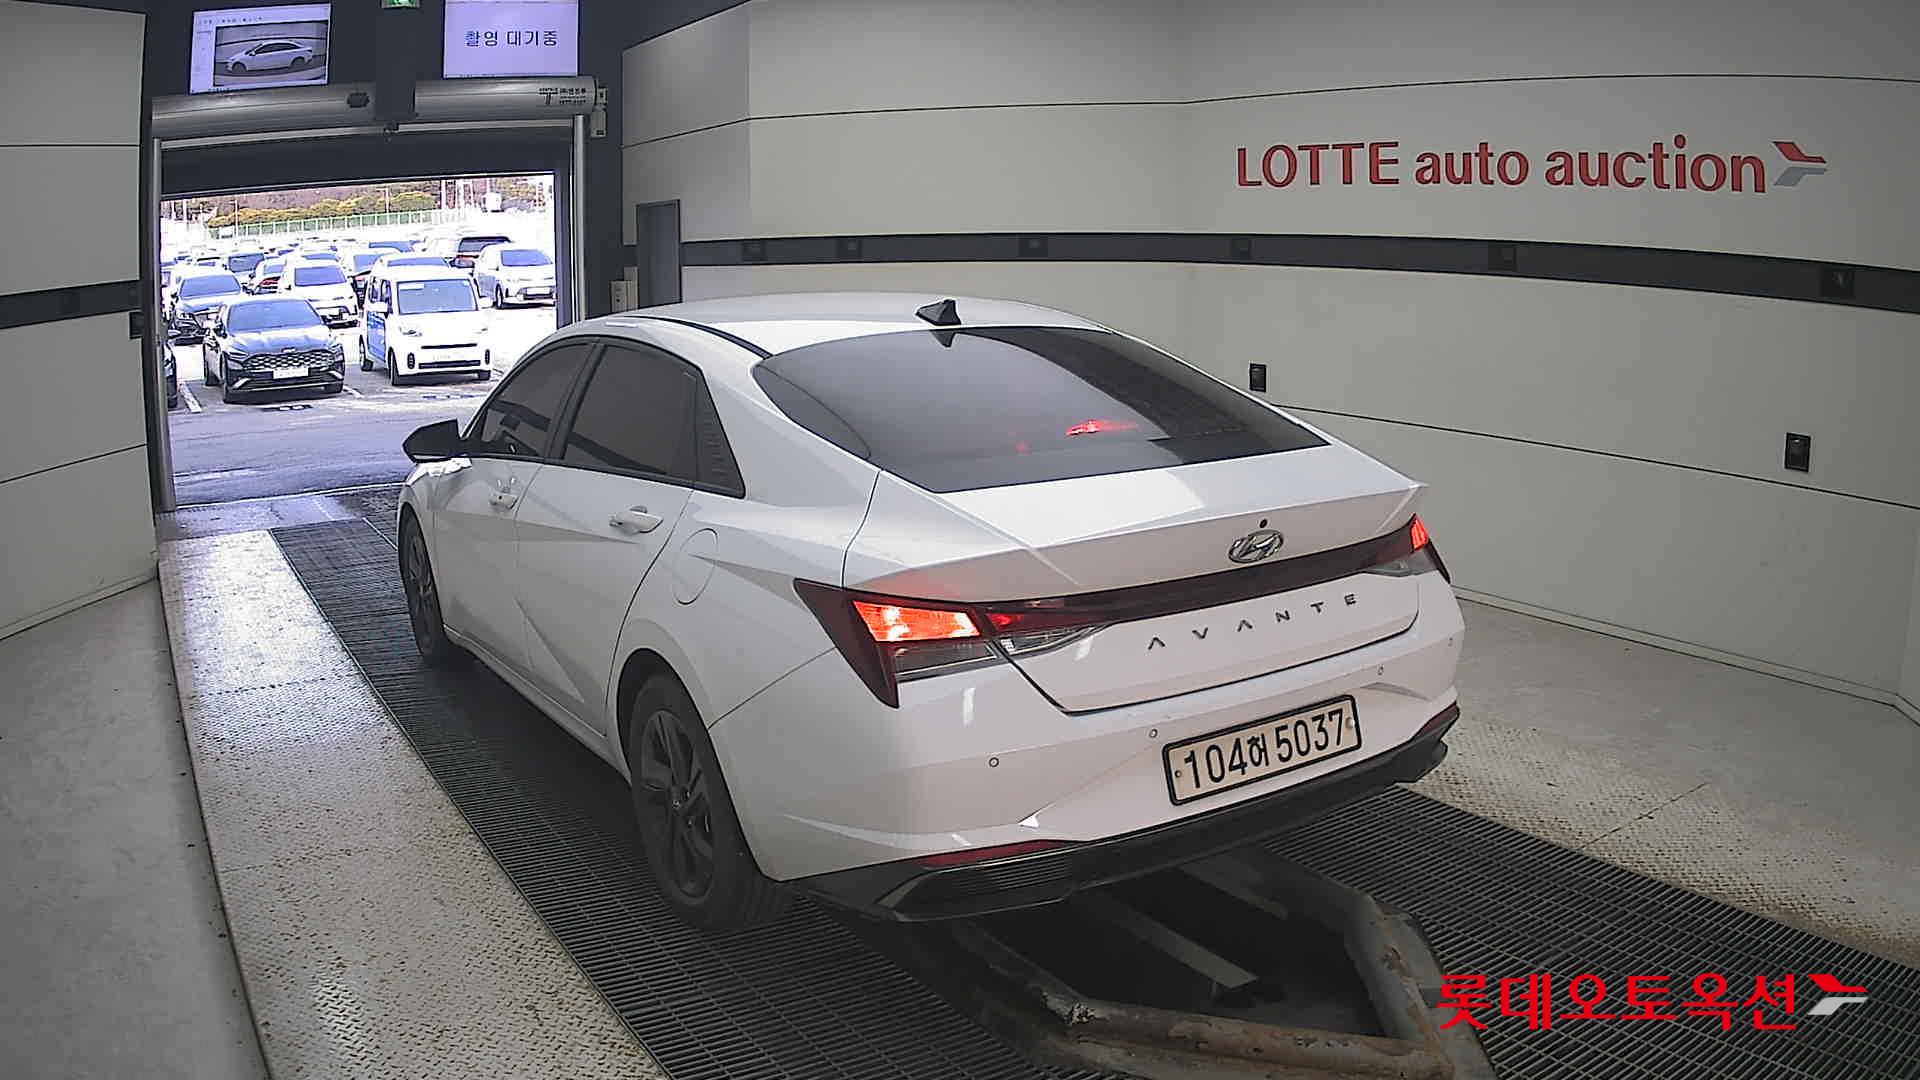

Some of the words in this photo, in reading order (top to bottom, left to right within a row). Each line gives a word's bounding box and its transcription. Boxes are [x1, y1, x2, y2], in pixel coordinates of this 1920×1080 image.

[465, 30, 498, 47] 촬영
[507, 30, 557, 47] 대기중
[1237, 141, 1400, 188] LOTTE
[1414, 142, 1529, 187] auto
[1544, 134, 1767, 194] auction
[1147, 593, 1358, 651] AVANTE
[1184, 733, 1270, 789] 104허
[1275, 707, 1345, 764] 5037
